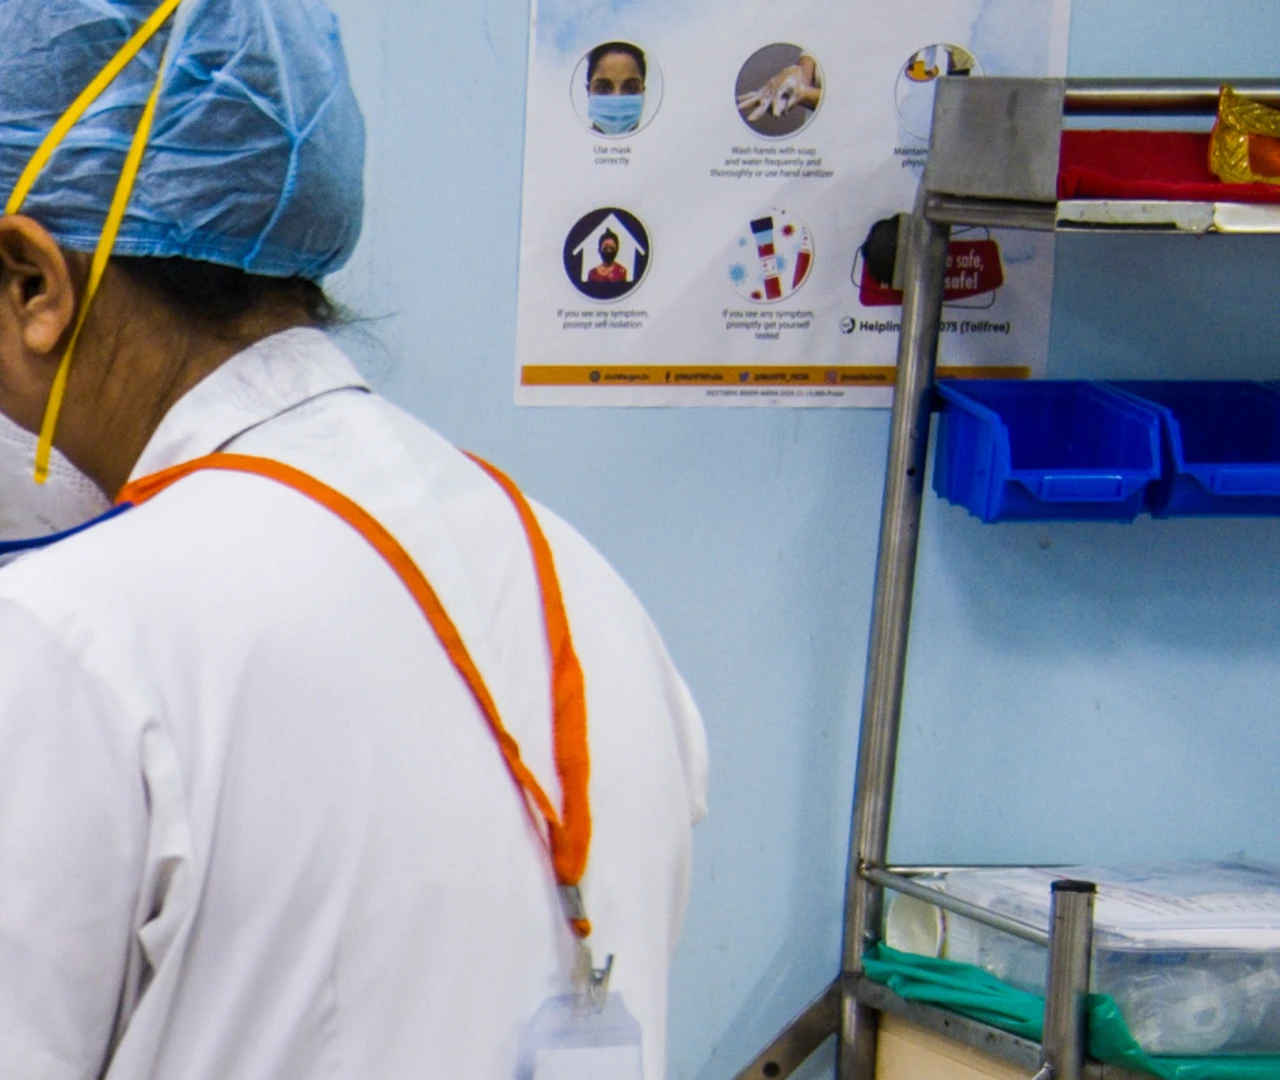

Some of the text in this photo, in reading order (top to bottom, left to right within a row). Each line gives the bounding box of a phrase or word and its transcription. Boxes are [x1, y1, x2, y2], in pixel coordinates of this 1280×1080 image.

[593, 144, 631, 154] Use mask
[753, 147, 777, 156] hands
[778, 147, 796, 156] with
[797, 148, 816, 158] soap
[594, 156, 630, 167] correctly
[724, 157, 822, 168] and water frequently and
[710, 169, 834, 179] thoroughly or use hand sanitizer
[956, 249, 984, 272] safe,
[944, 271, 979, 290] safe!
[564, 311, 580, 320] you
[596, 311, 609, 320] any
[729, 310, 744, 319] you
[745, 310, 758, 318] see
[759, 311, 774, 320] any
[563, 321, 592, 331] prompt
[726, 320, 810, 331] promptly get yourself
[859, 320, 901, 335] Helplin
[959, 320, 1011, 335] (Tollfree)
[754, 331, 780, 340] tested
